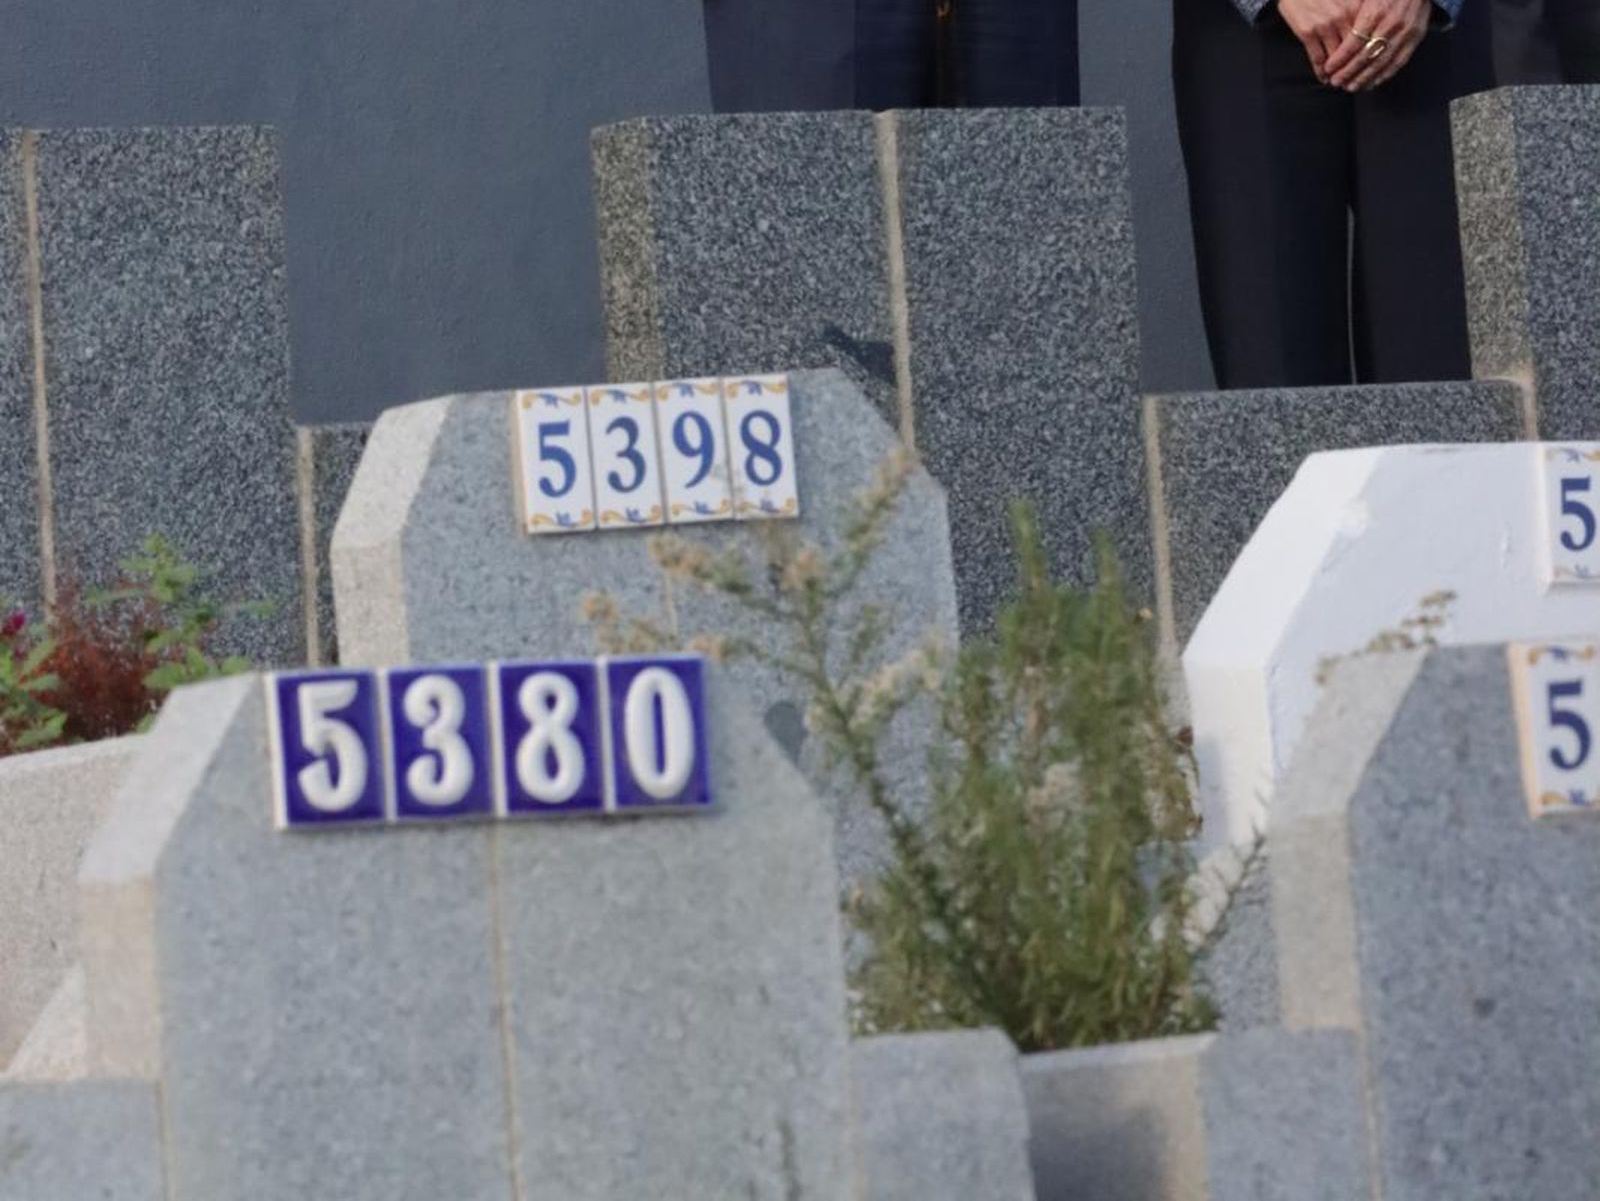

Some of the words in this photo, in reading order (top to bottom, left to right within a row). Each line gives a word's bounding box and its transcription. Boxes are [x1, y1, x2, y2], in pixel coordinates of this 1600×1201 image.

[538, 410, 783, 497] 5398
[1560, 475, 1596, 551] 5
[298, 666, 695, 812] 5380
[1548, 678, 1591, 770] 5
